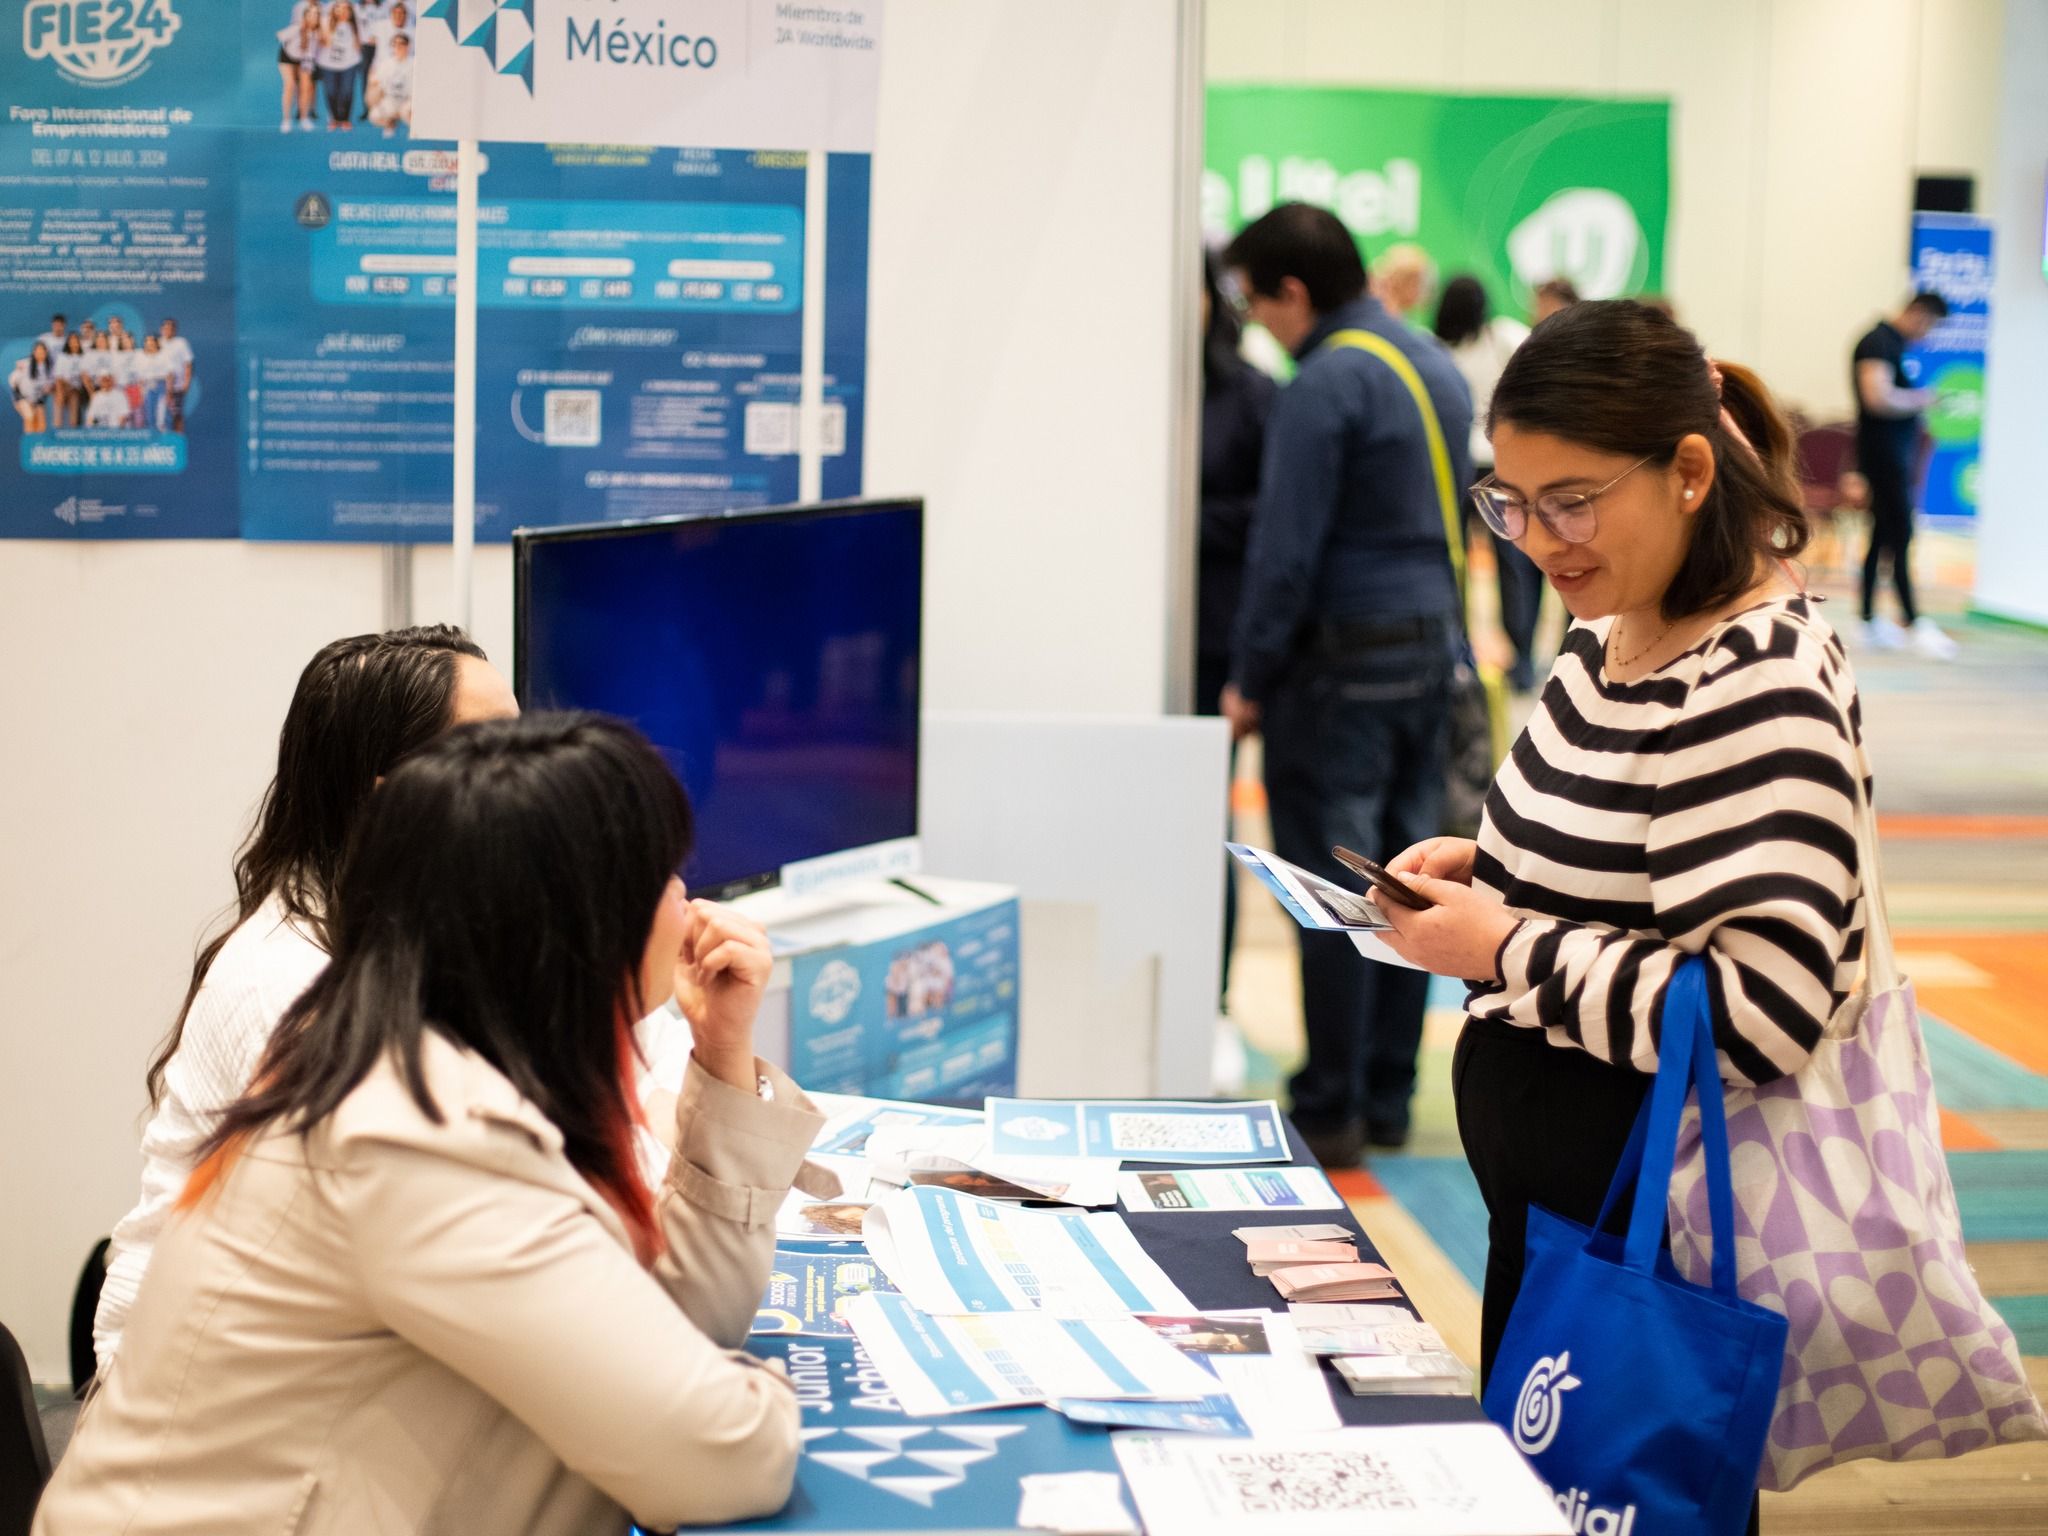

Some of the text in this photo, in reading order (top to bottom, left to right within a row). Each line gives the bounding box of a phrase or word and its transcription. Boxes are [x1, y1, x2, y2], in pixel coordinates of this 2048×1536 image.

[775, 3, 865, 26] Miembro de
[24, 0, 180, 58] FIE24
[799, 29, 875, 51] Worldwide
[566, 15, 718, 69] México
[9, 105, 193, 124] Foro Internacional de
[32, 121, 170, 138] Emprendedores
[770, 1282, 785, 1306] SOCIOS
[788, 1343, 834, 1414] Junior
